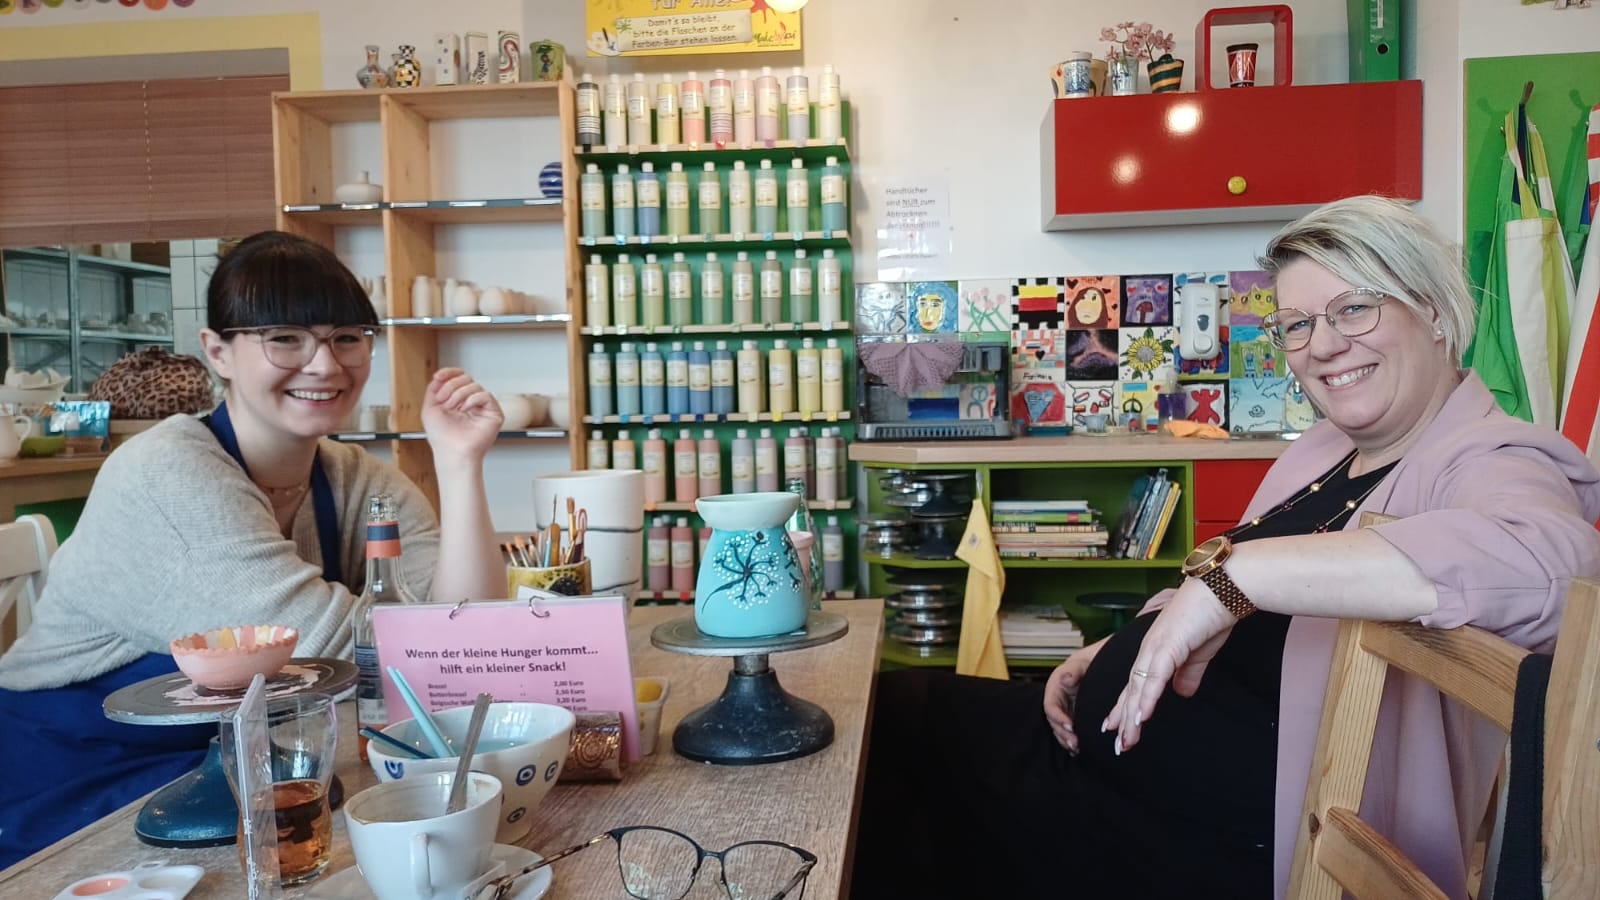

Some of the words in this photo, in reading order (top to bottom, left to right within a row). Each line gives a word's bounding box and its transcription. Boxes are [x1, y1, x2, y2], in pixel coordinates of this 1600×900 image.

[633, 30, 654, 38] bitte
[672, 26, 707, 35] Flaschen
[680, 37, 708, 45] stehen
[405, 649, 438, 658] Wenn
[441, 649, 460, 658] der
[463, 648, 498, 658] kleine
[501, 647, 542, 659] Hunger
[545, 646, 598, 656] kommt...
[440, 664, 463, 674] hilft
[466, 664, 483, 673] ein
[486, 663, 525, 673] kleiner
[528, 661, 566, 672] Snack!
